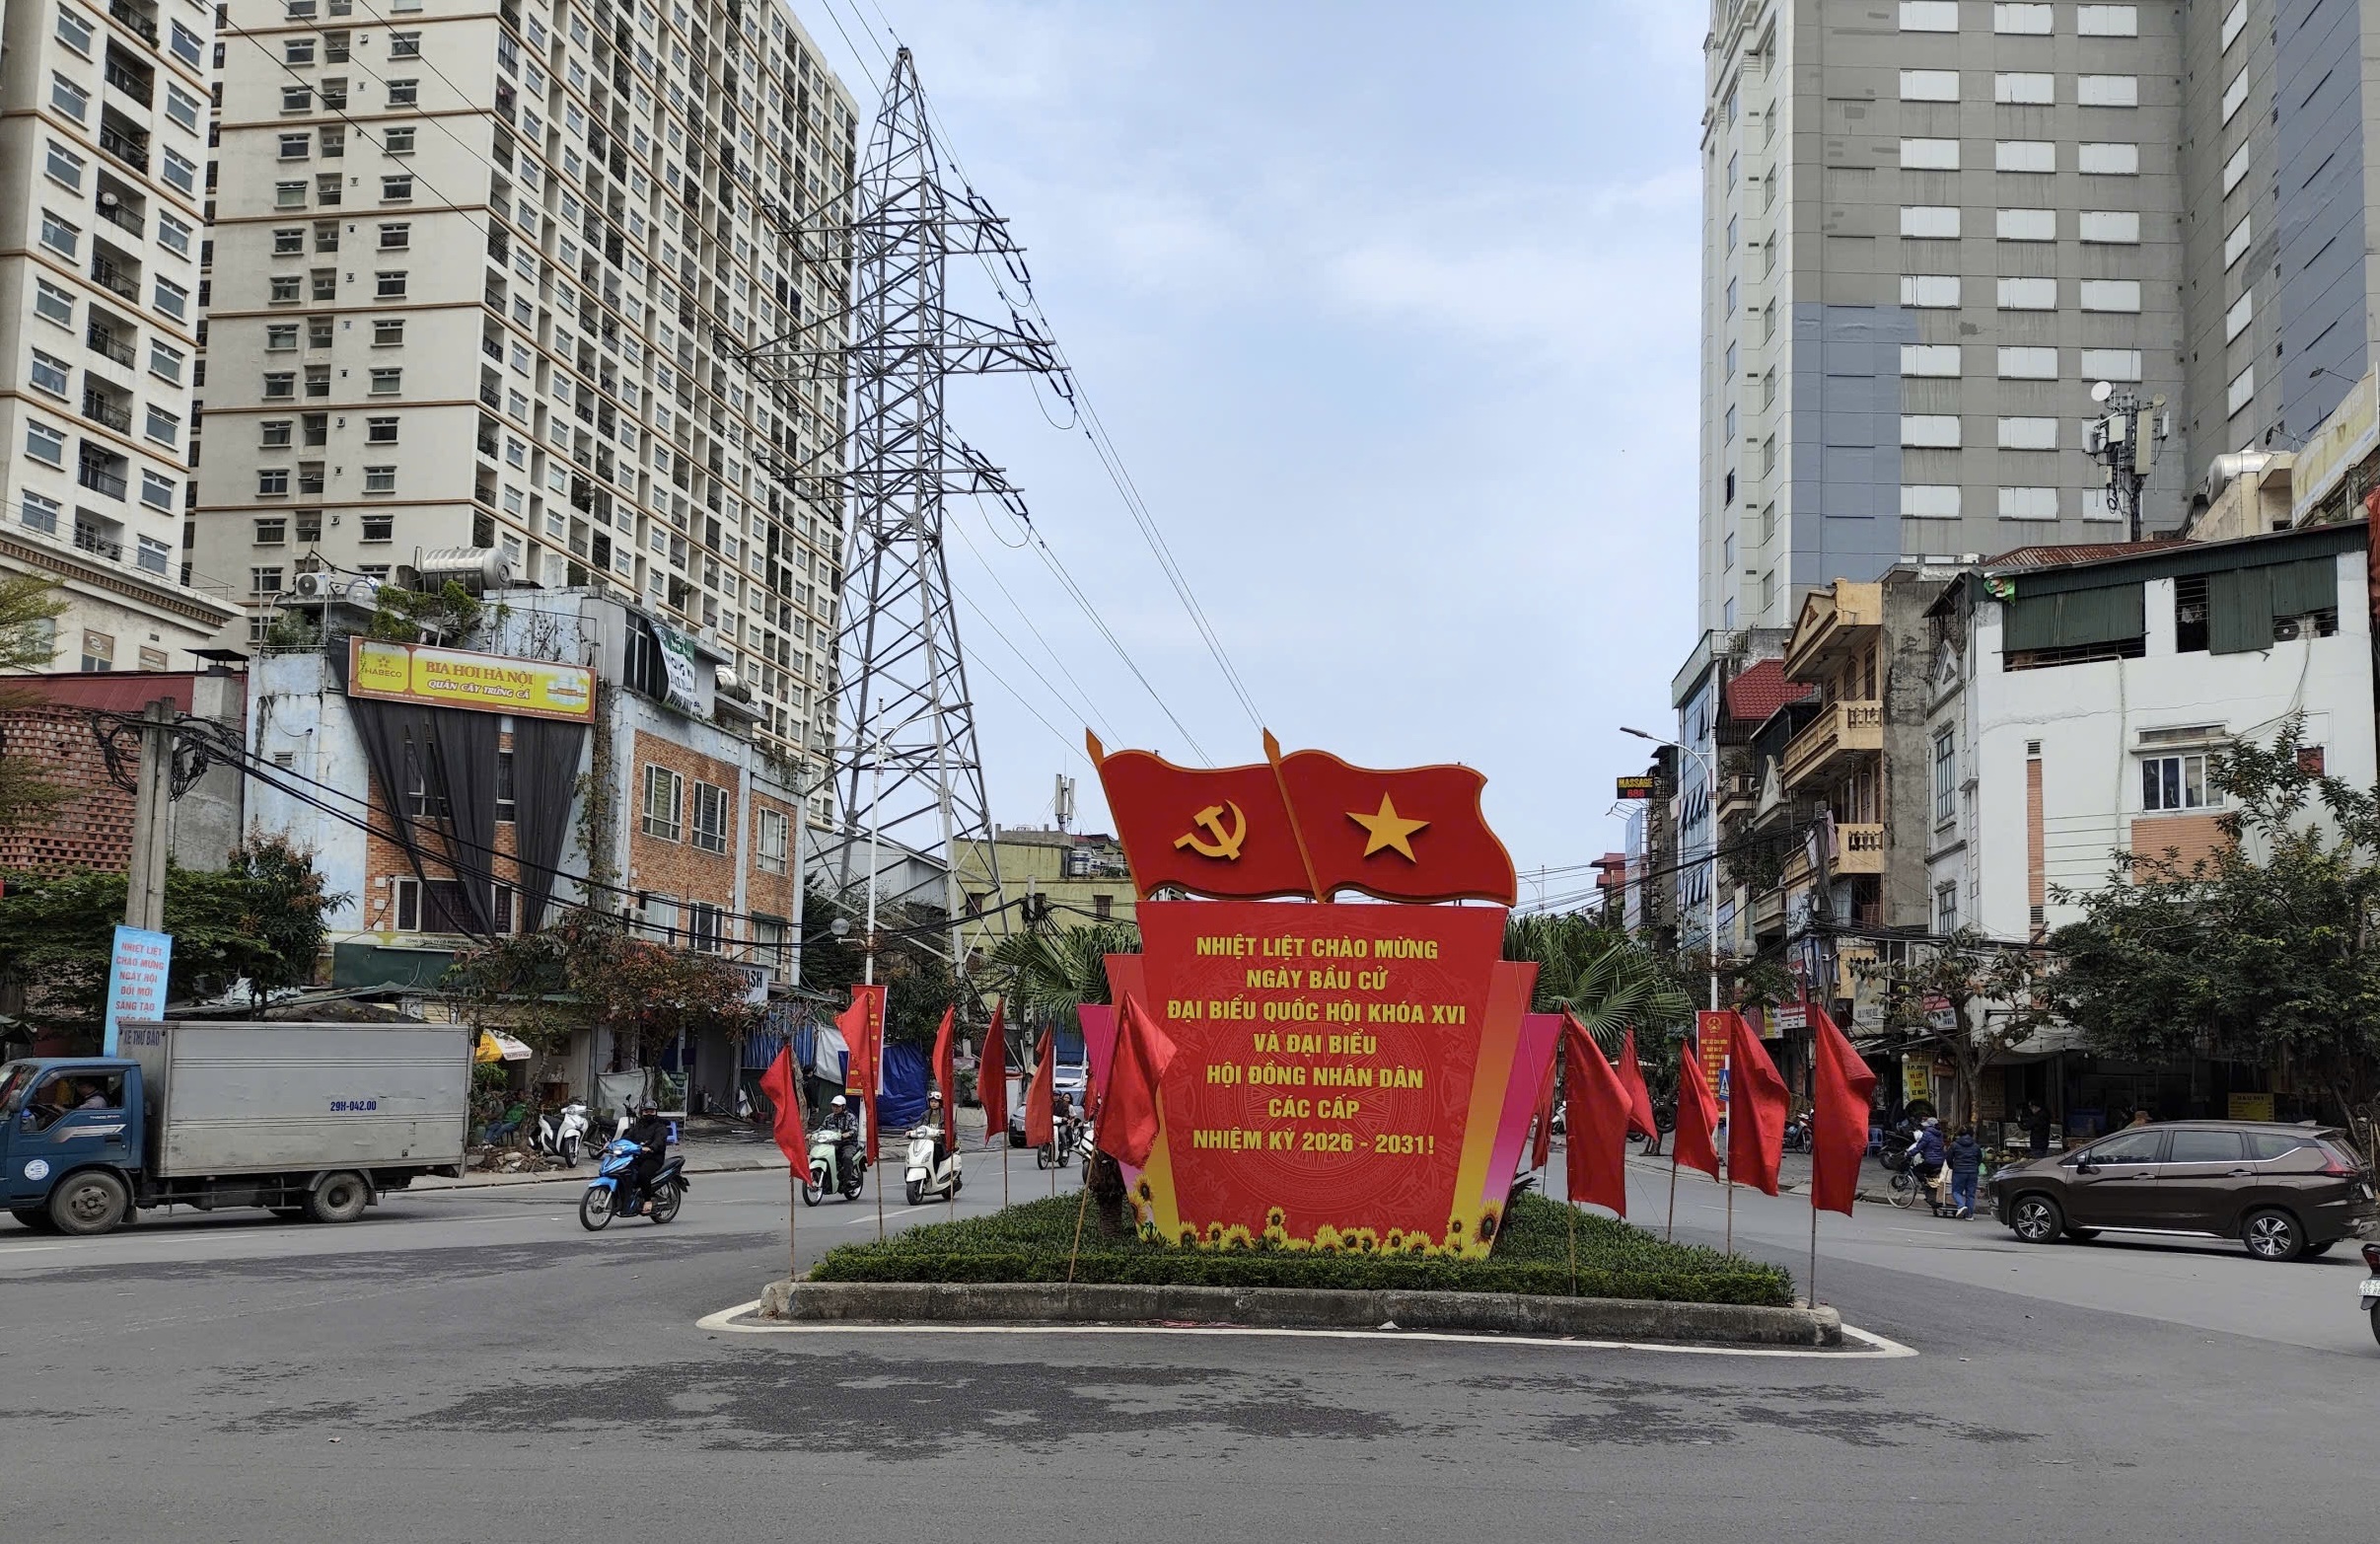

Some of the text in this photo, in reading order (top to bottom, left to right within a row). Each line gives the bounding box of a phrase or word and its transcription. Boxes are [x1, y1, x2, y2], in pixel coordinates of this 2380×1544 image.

[364, 668, 402, 679] HABECO
[425, 661, 534, 688] BIA HƠI HÀ NỘI
[427, 678, 460, 693] QUÁN
[517, 688, 531, 700] CÁ
[121, 941, 163, 957] NHIỆT LIỆT
[1195, 934, 1438, 961] NHIỆT LIỆT CHÀO MỪNG
[1246, 964, 1389, 991] NGÀY BẦU CỬ
[139, 1001, 155, 1013] TẠO
[1167, 993, 1467, 1026] ĐẠI BIỂU QUỐC HỘI KHÓA XVI
[124, 1029, 132, 1045] XE
[1253, 1028, 1377, 1058] VÀ ĐẠI BIỂU
[1206, 1061, 1423, 1089] HỘI ĐỒNG NHÂN DÂN
[330, 1100, 377, 1112] 29H-042.00
[1268, 1093, 1360, 1120] CÁC CẤP
[1193, 1126, 1262, 1153] NHIỆM
[1268, 1128, 1295, 1151] KỲ
[1302, 1132, 1353, 1153] 2026
